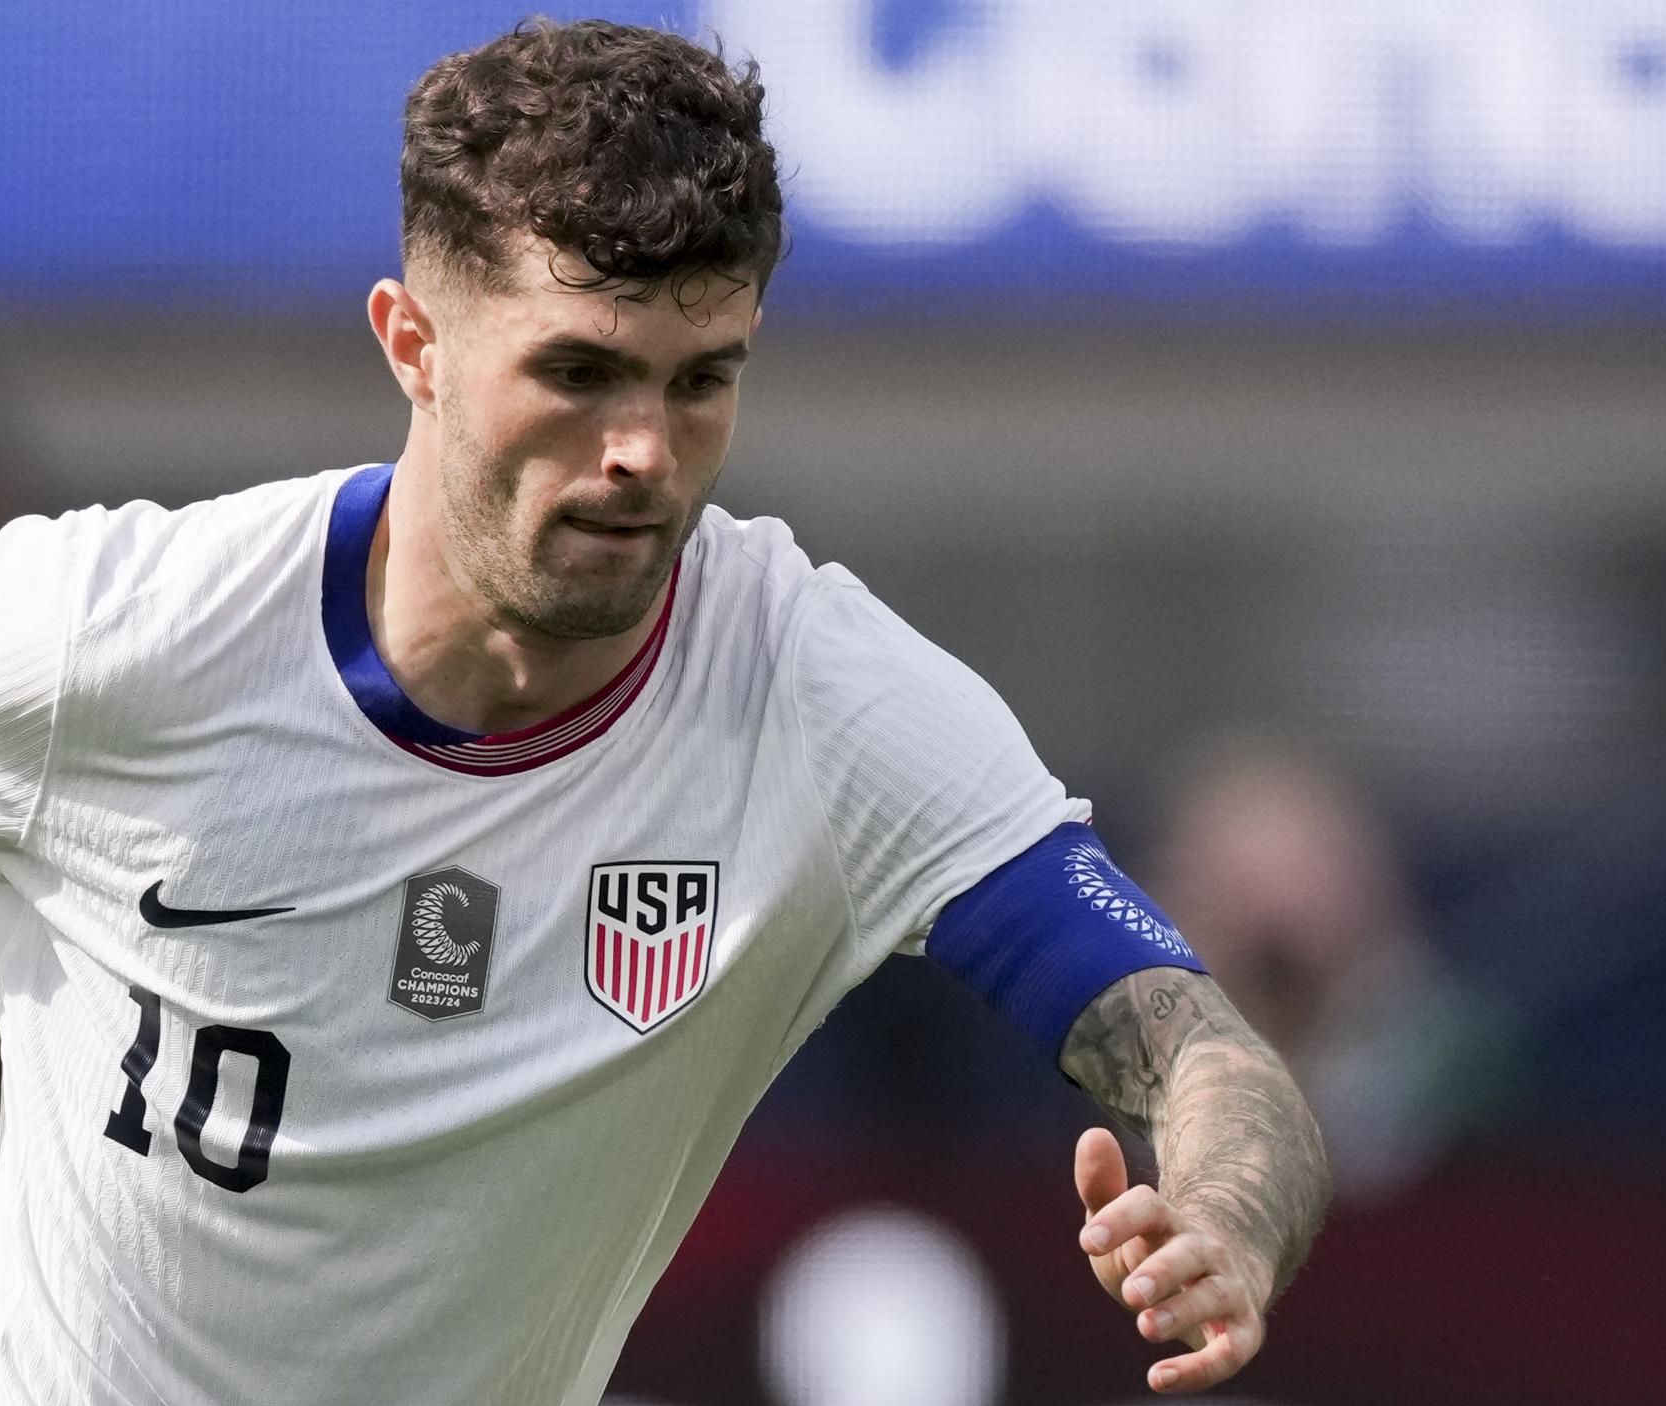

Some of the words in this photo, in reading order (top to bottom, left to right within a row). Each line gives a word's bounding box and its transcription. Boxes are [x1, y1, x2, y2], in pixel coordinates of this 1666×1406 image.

[598, 872, 707, 935] USA
[411, 967, 469, 983] Concacaf
[397, 979, 479, 998] CHAMPIONS
[411, 994, 460, 1007] 2023/24
[104, 986, 290, 1193] 10
